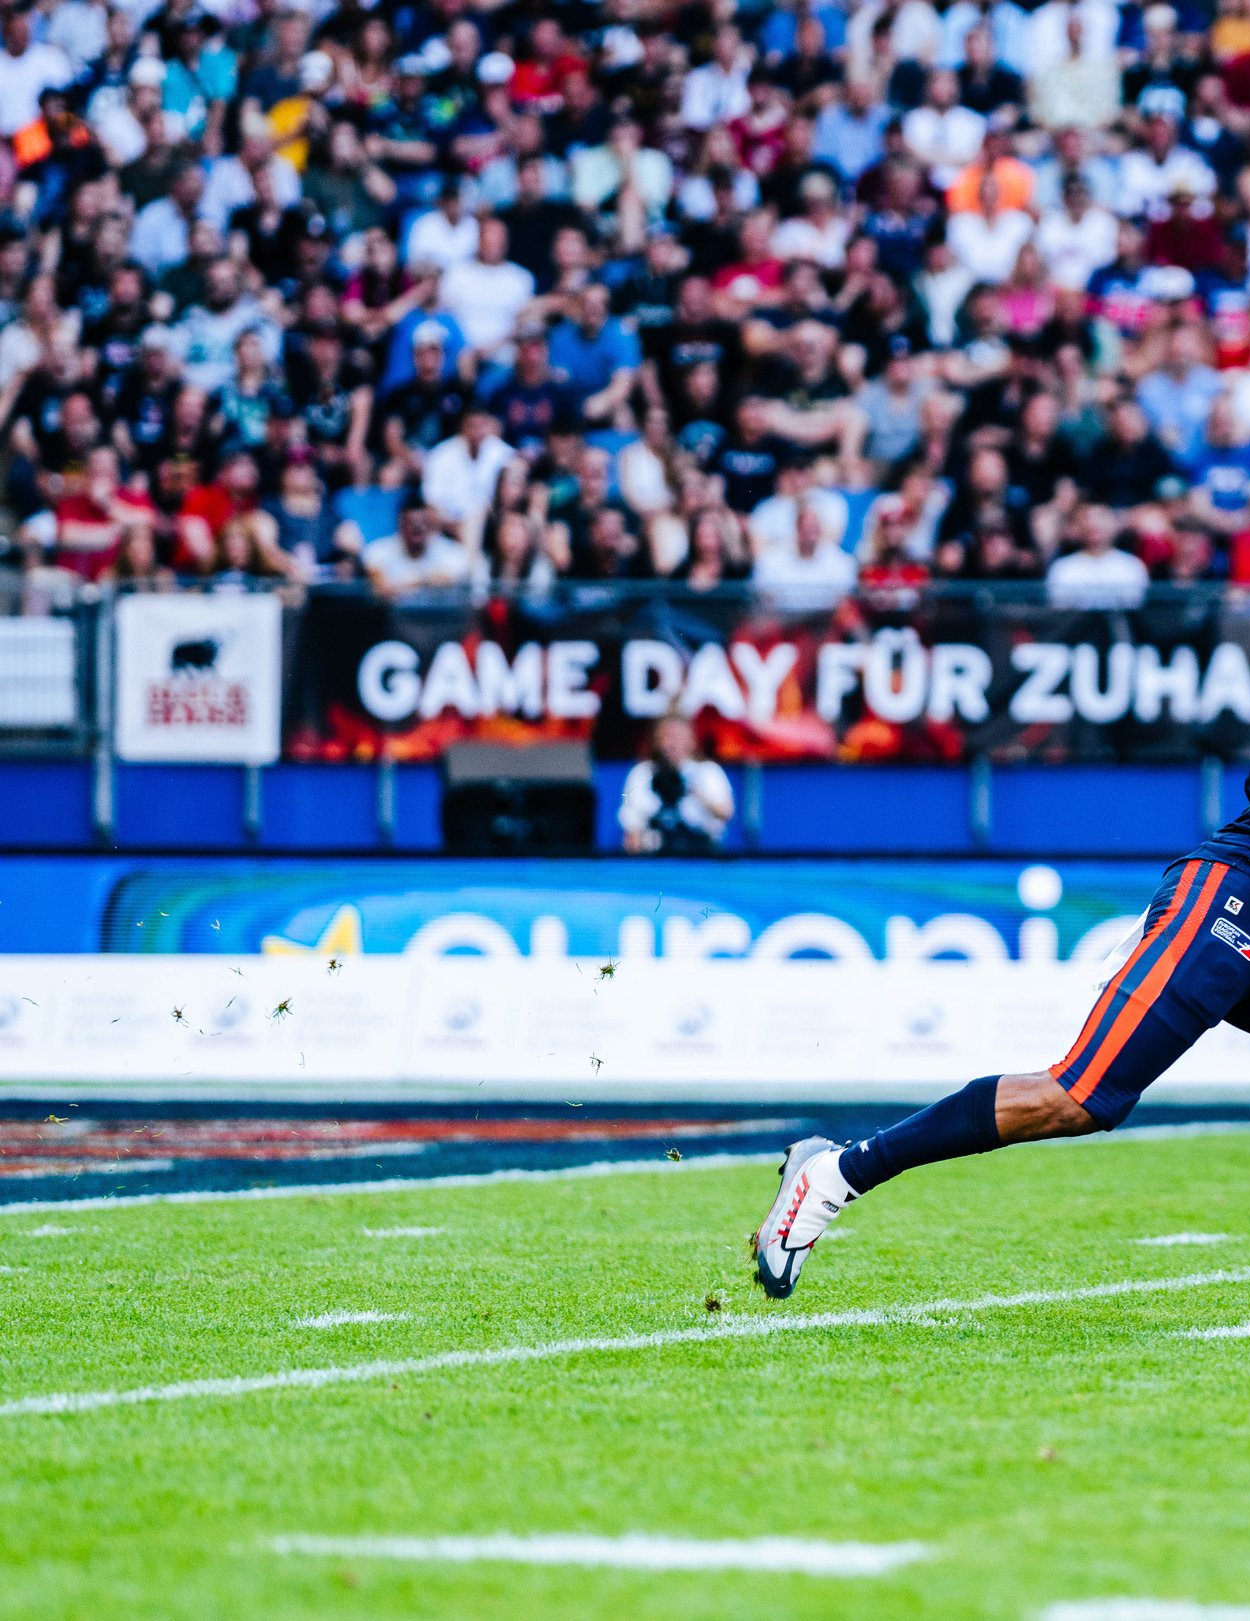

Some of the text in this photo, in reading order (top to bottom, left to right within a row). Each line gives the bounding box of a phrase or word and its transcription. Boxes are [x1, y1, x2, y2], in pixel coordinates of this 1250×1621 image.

[356, 640, 600, 720] GAME
[621, 640, 799, 720] DAY
[816, 626, 993, 723] FÜR
[1214, 928, 1236, 944] FOOTBALL
[1218, 920, 1242, 938] EUROPEAN
